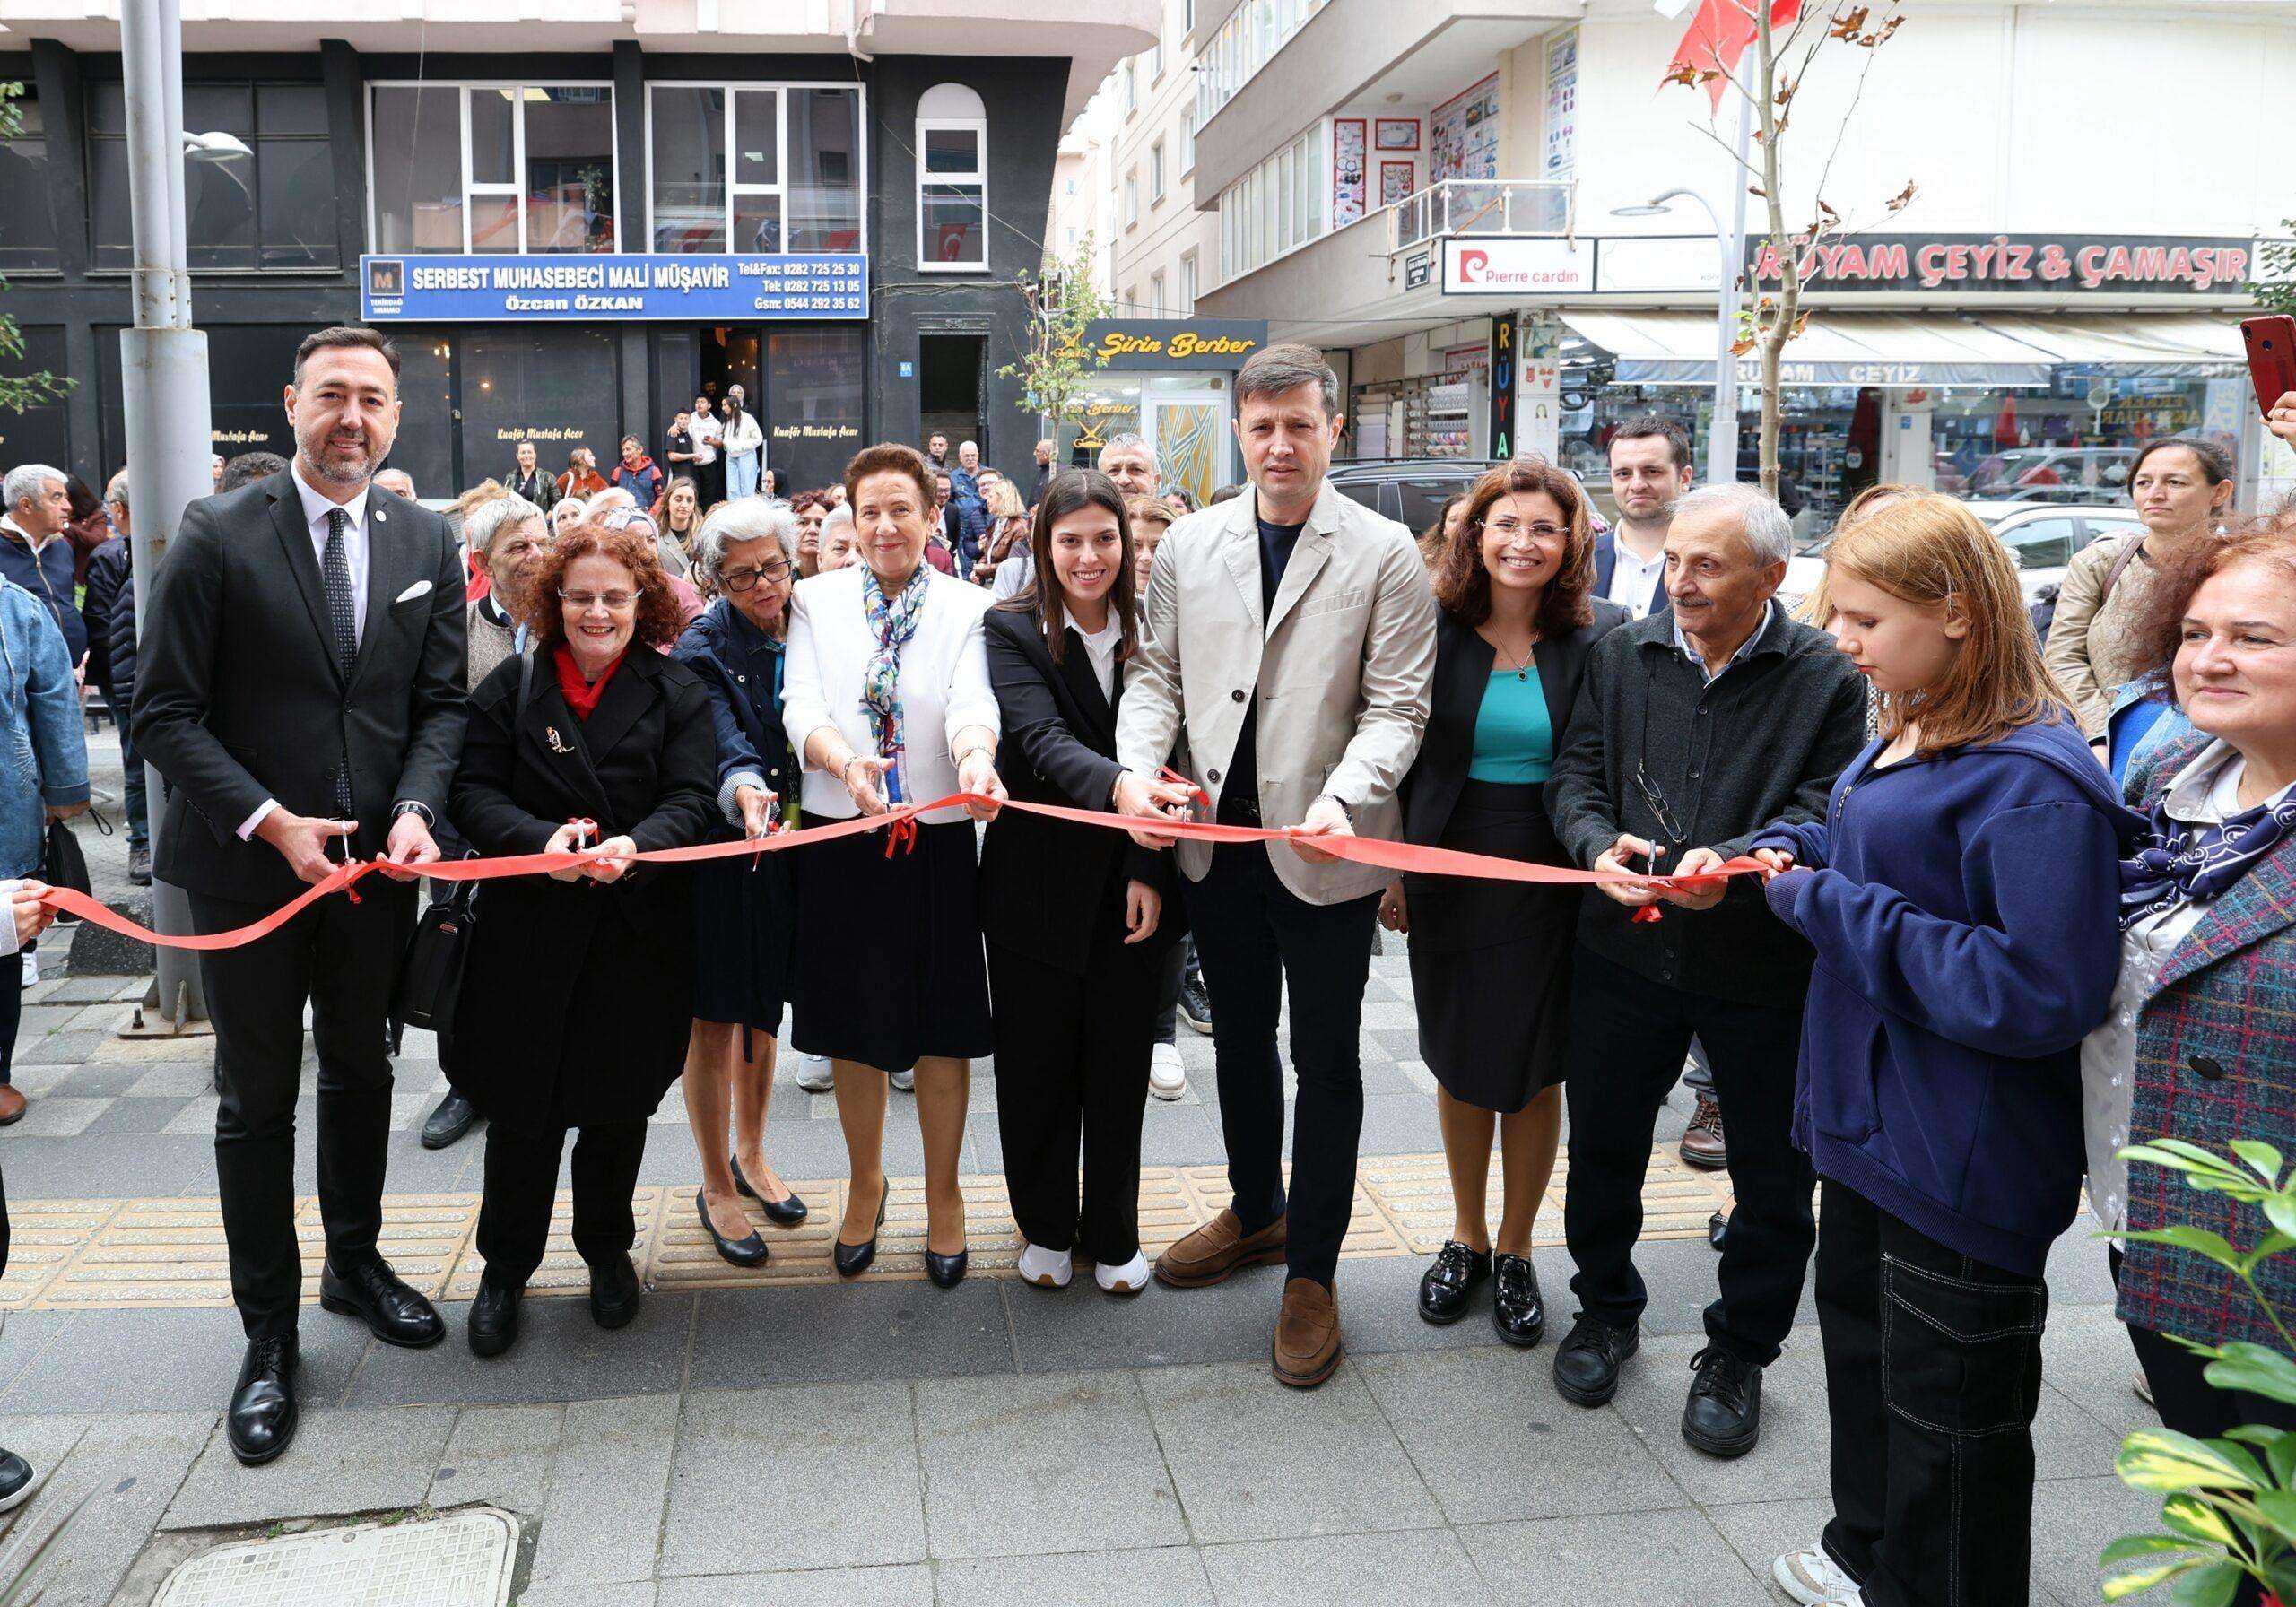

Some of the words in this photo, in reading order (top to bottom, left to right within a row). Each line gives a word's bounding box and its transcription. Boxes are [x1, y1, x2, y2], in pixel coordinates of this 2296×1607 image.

[737, 263, 781, 276] Tel&Fax:
[784, 263, 809, 276] 0282
[812, 263, 830, 276] 725
[832, 263, 845, 276] 25
[848, 263, 860, 276] 30
[1916, 235, 2033, 288] ÇEYİZ
[2037, 244, 2071, 281] &
[2075, 245, 2248, 290] ÇAMAŞIR
[413, 267, 491, 290] SERBEST
[493, 264, 604, 290] MUHASEBECİ
[608, 263, 649, 289] MALİ
[654, 263, 730, 293] MÜŞAVİR
[1485, 270, 1528, 282] Pierre
[1532, 270, 1578, 282] cardin
[762, 280, 781, 293] Tel:
[784, 280, 809, 293] 0282
[812, 280, 830, 293] 725
[832, 280, 845, 293] 13
[848, 280, 860, 293] 05
[505, 294, 569, 311] Özcan
[574, 294, 644, 310] ÖZKAN
[754, 297, 781, 310] Gsm:
[784, 297, 809, 310] 0544
[812, 297, 830, 310] 292
[832, 297, 845, 310] 35
[848, 297, 860, 310] 62
[1096, 333, 1162, 360] Şirin
[1167, 332, 1256, 358] Berber
[212, 430, 247, 444] Mustafa
[498, 428, 525, 440] Kuaför
[526, 428, 562, 441] Mustafa
[774, 426, 800, 439] Kuaför
[803, 425, 838, 439] Mustafa
